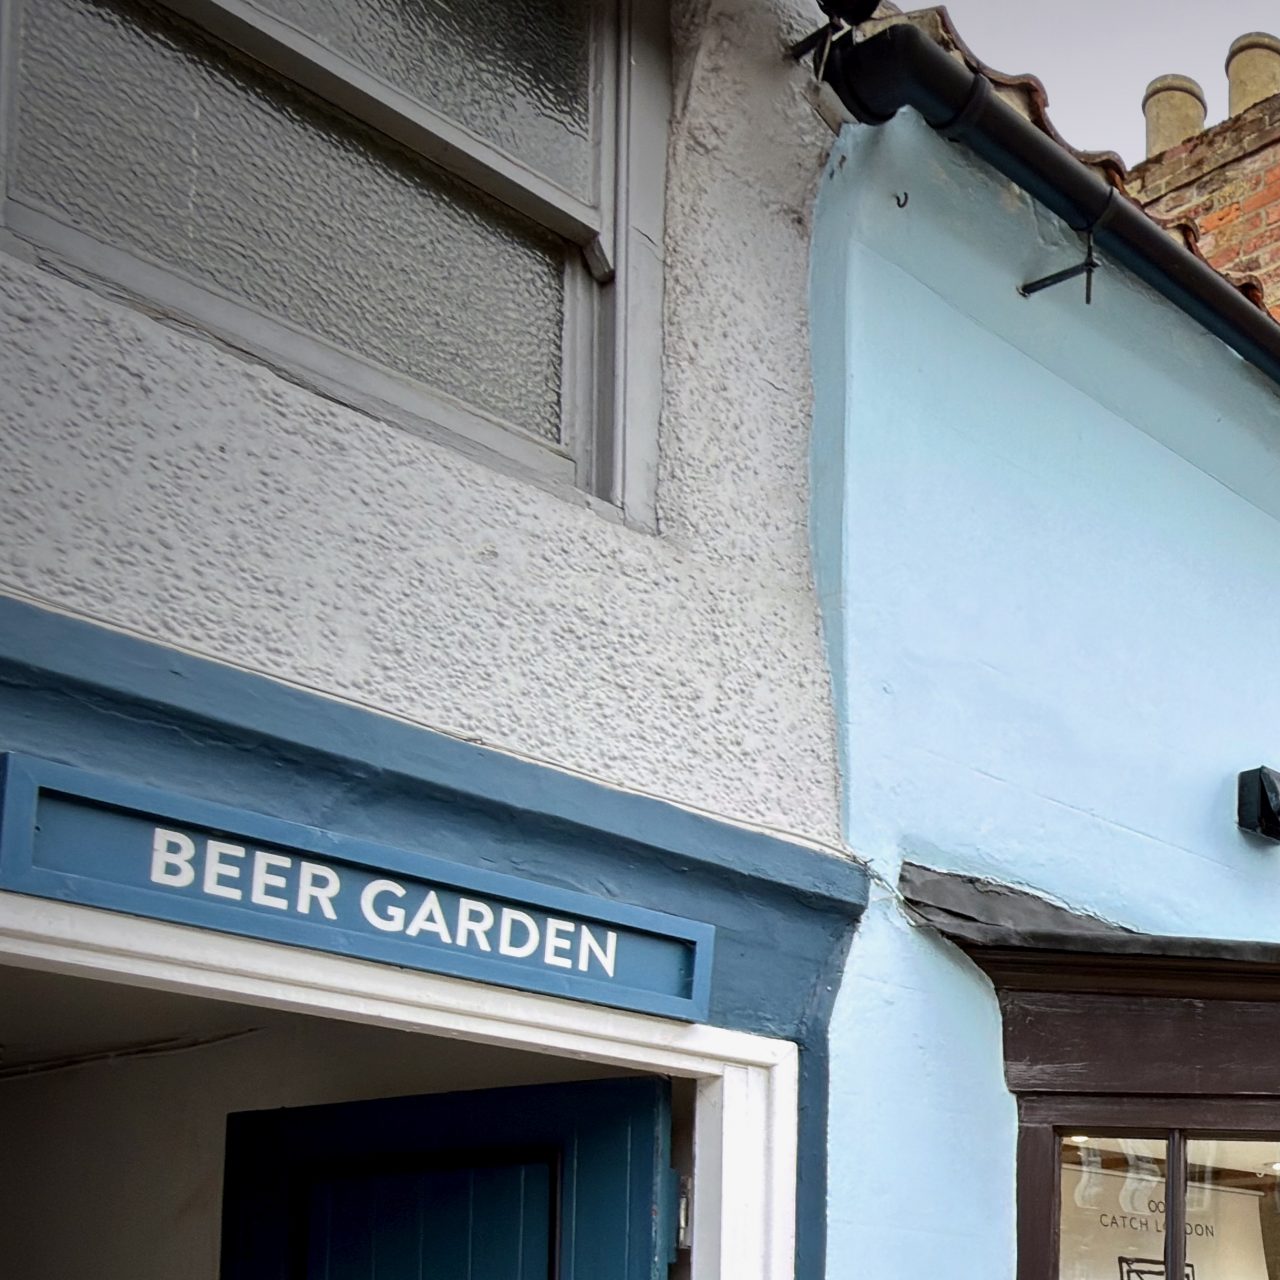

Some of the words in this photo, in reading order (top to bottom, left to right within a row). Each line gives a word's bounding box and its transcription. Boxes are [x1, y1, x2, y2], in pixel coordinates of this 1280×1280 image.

[151, 827, 341, 920] BEER
[360, 879, 618, 978] GARDEN
[1100, 1213, 1149, 1231] CATCH
[1155, 1220, 1214, 1237] LDON
